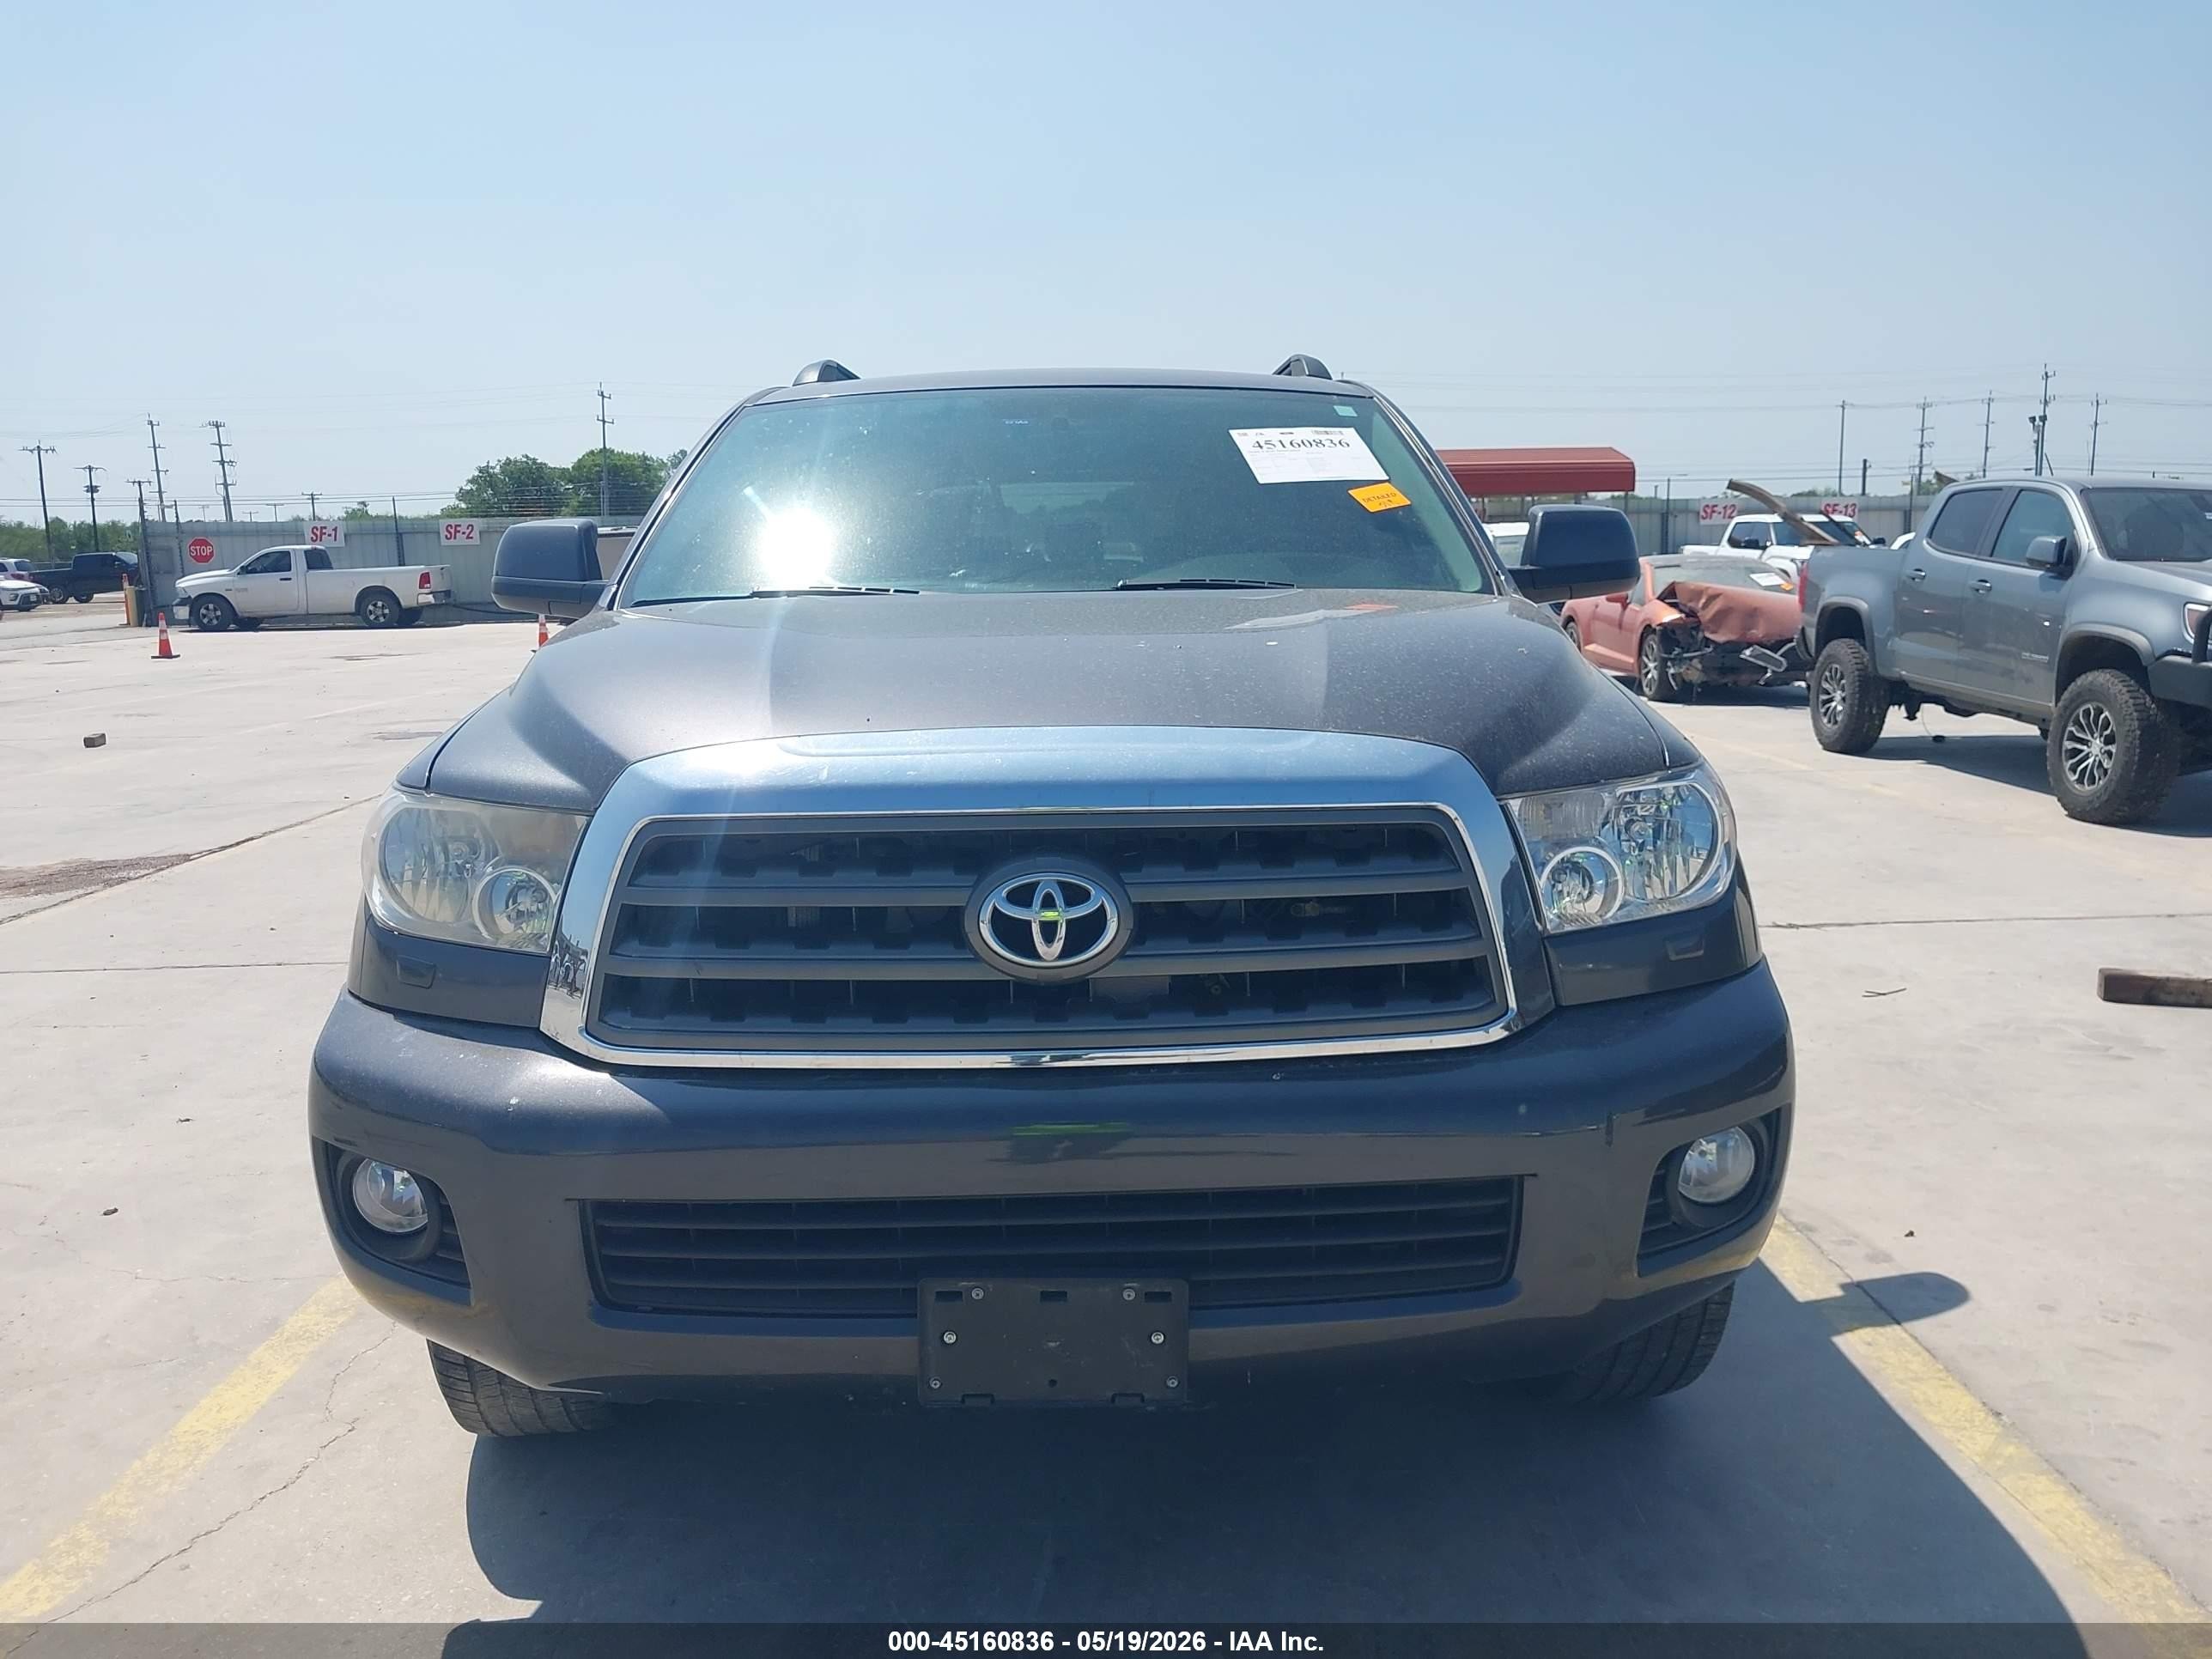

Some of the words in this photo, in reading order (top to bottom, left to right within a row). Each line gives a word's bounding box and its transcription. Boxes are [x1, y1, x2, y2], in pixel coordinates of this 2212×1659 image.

[1252, 438, 1351, 450] 45160836
[1362, 492, 1396, 503] DETAILED
[1701, 504, 1736, 520] SF-12
[1824, 503, 1856, 518] SF-13
[310, 526, 338, 543] SF-1
[445, 524, 474, 540] SF-2
[190, 545, 213, 556] STOP
